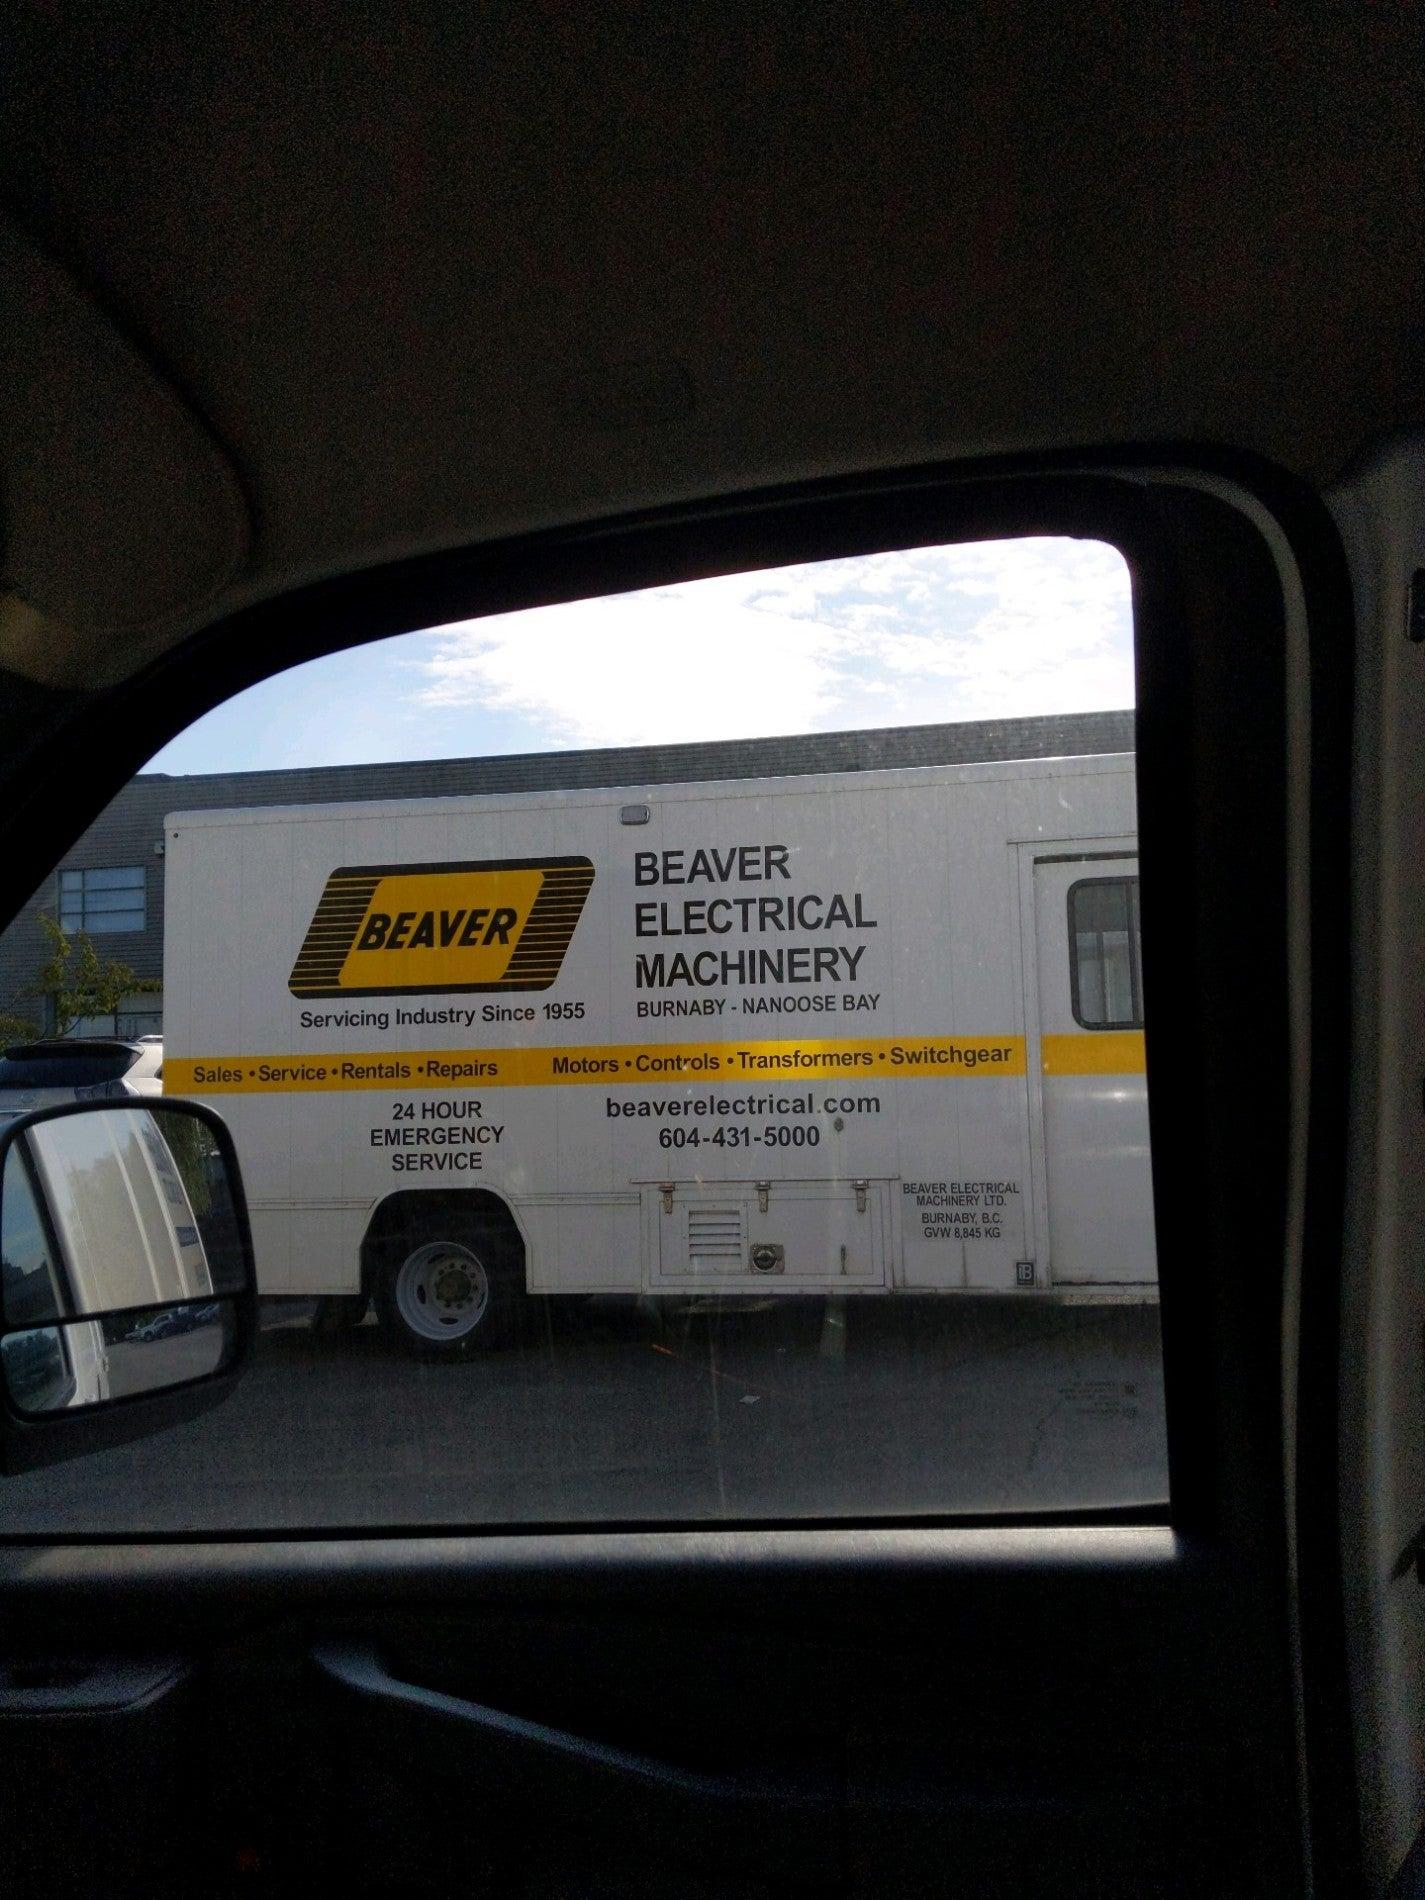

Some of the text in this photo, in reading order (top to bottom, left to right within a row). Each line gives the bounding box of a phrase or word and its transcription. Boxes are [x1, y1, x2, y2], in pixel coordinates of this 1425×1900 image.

[635, 845, 792, 886] BEAVER
[635, 893, 878, 937] ELECTRICAL
[356, 908, 517, 950] BEAVER
[636, 945, 867, 988] MACHINERY
[300, 1003, 585, 1030] Servicing Industry Since 1955
[637, 999, 726, 1017] BURNABY
[743, 995, 836, 1014] NANOOSE
[842, 994, 880, 1011] BAY
[193, 1059, 498, 1083] Sales Service Rentals Repairs
[552, 1045, 1012, 1074] Motors Controls Transformers Switchgear
[393, 1101, 482, 1120] 24 HOUR
[606, 1094, 881, 1119] beaverelectrical.com
[370, 1126, 504, 1146] EMERGENCY
[659, 1126, 820, 1149] 604-431-5000
[392, 1152, 482, 1171] SERVICE
[903, 1182, 1019, 1194] BEAVER ELECTRICAL
[916, 1195, 1006, 1206] MACHINERY LTD.
[922, 1212, 1002, 1225] BURNABY, B.C.
[924, 1227, 1000, 1240] GVW 8,845 KG
